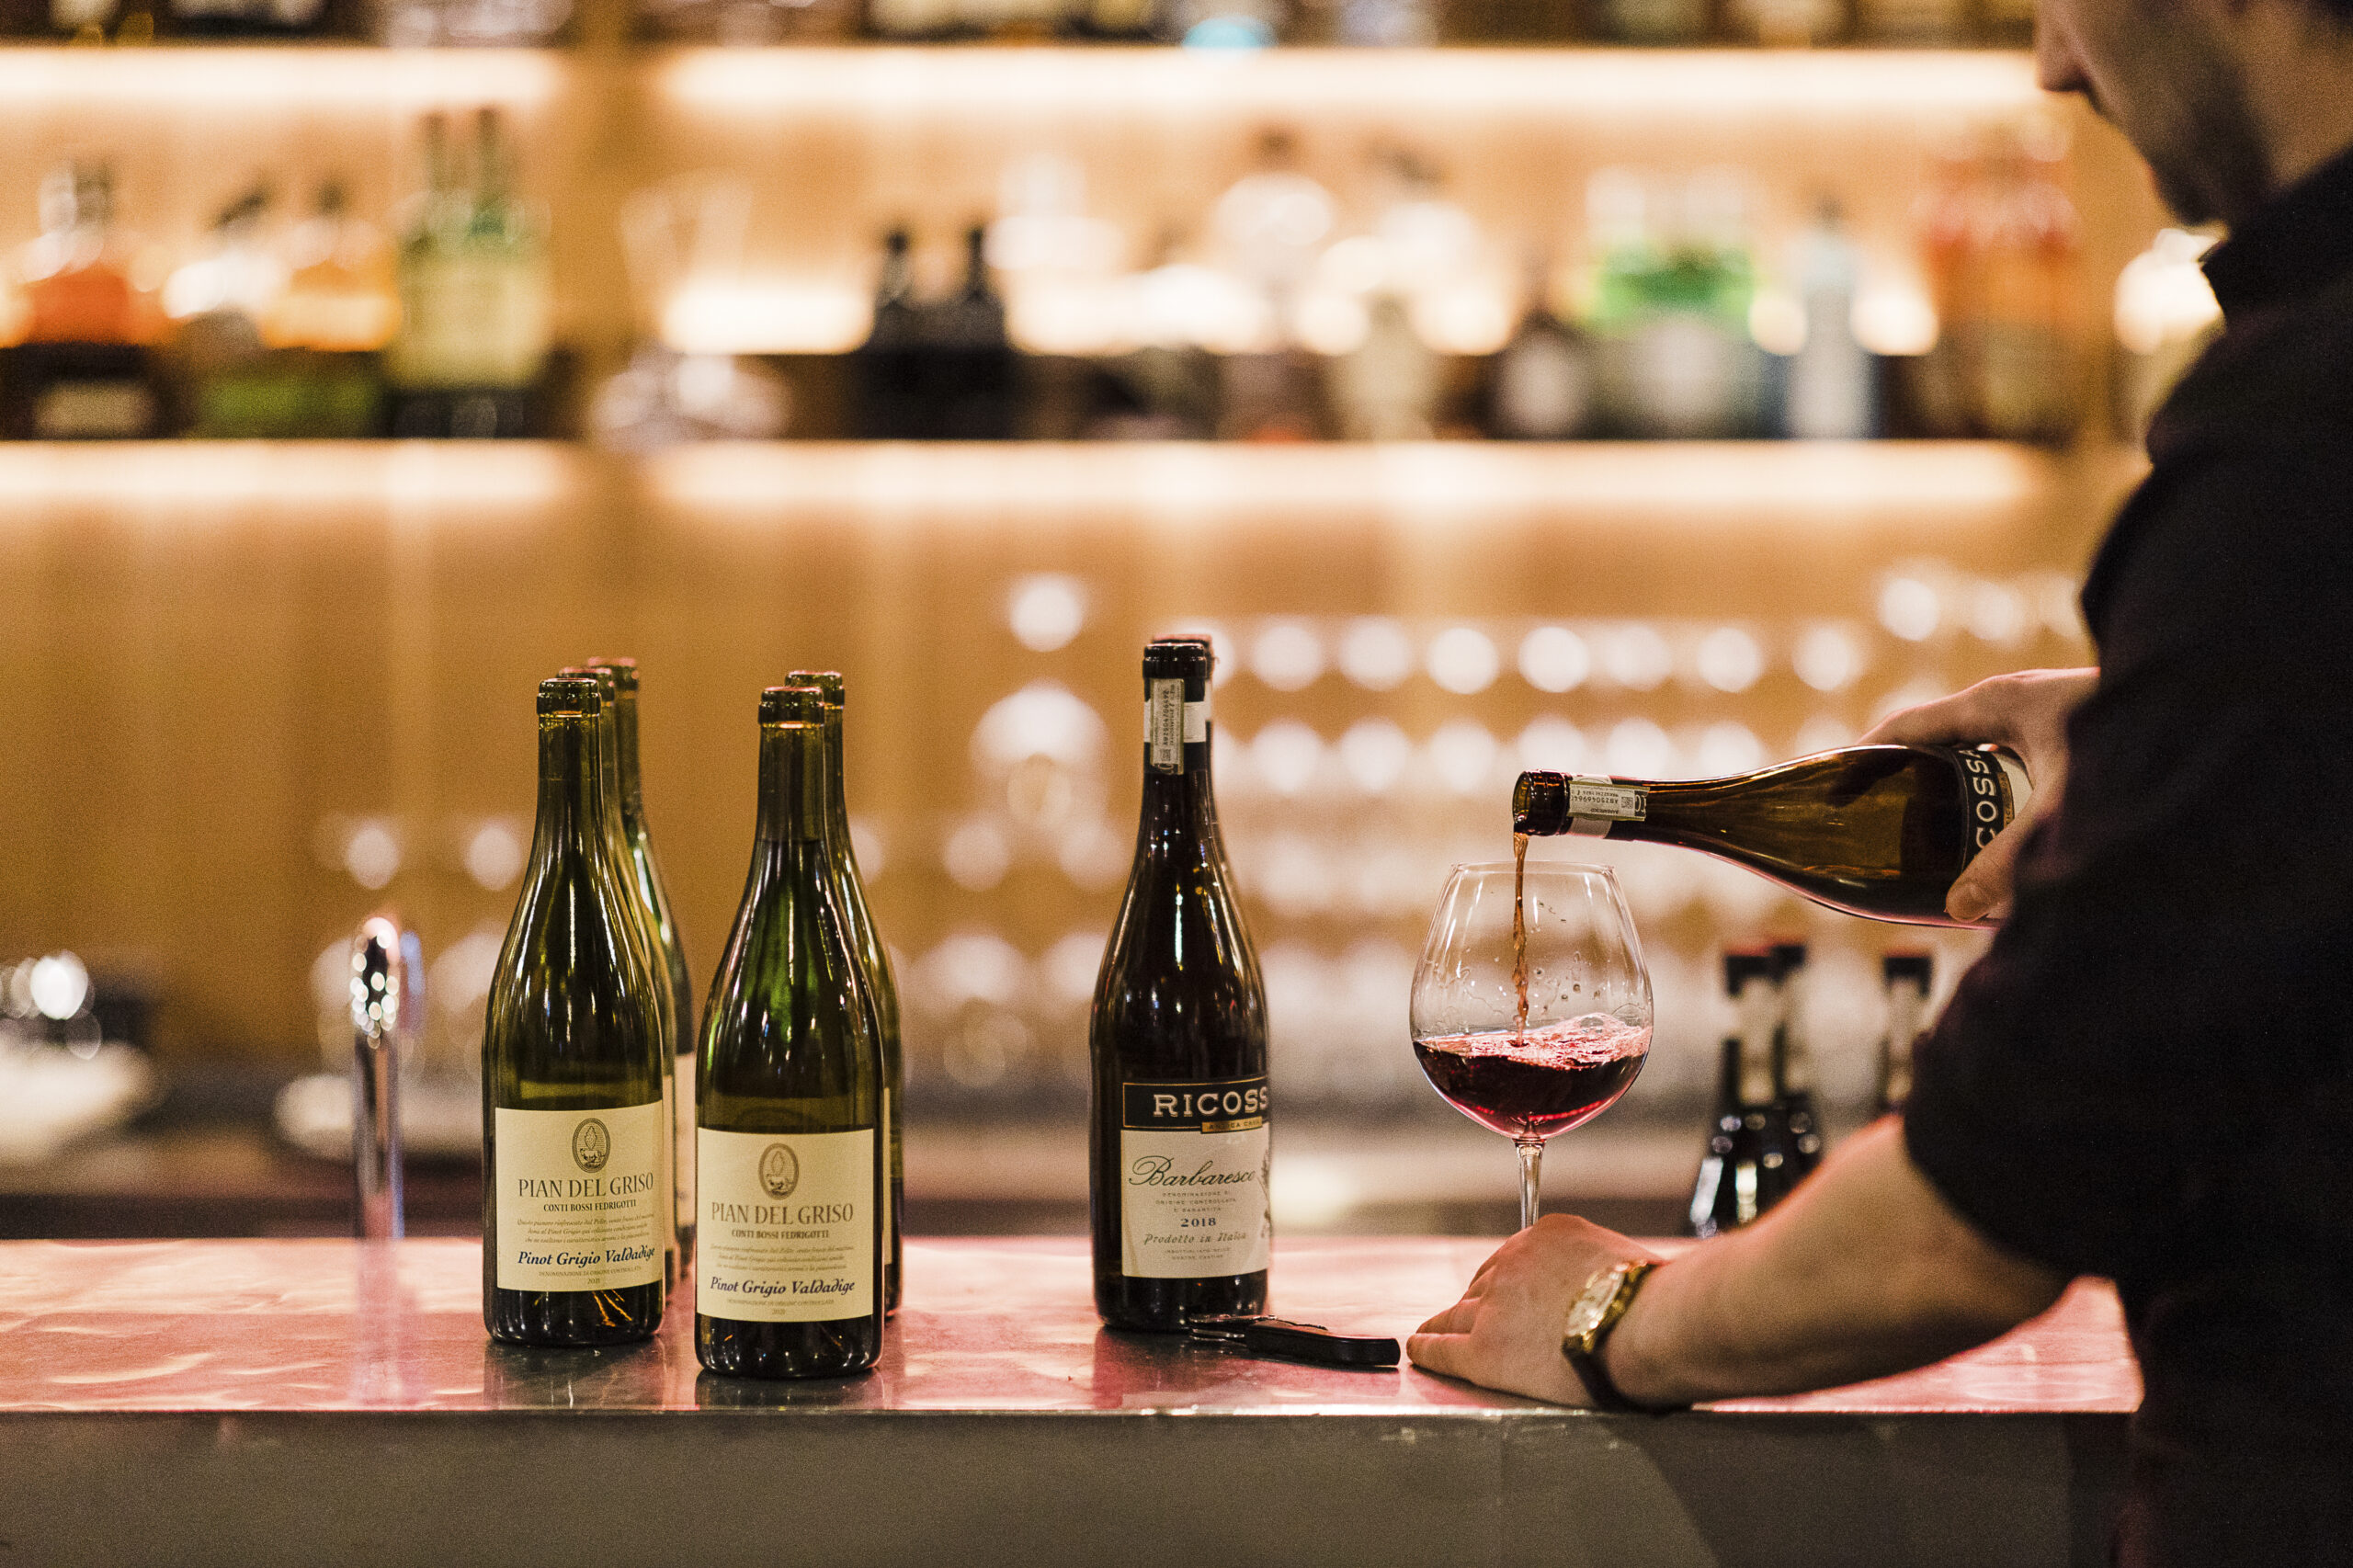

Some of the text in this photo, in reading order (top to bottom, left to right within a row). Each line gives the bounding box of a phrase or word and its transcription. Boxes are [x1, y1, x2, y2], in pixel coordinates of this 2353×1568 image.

[1959, 749, 1996, 849] COSSA
[1153, 1085, 1268, 1118] RICOSS
[1128, 1154, 1256, 1187] Barbaresco
[518, 1172, 654, 1198] PIAN DEL GRISO
[543, 1199, 637, 1212] CONTI BOSSI FEDRIGOTTI
[711, 1201, 854, 1225] PIAN DEL GRISO
[732, 1229, 829, 1239] CONTI BOSSI FEDRIGOTTI
[1180, 1217, 1217, 1228] 2018
[1143, 1232, 1247, 1245] Prodotto in Italia
[517, 1244, 655, 1268] Pinot Grigio Valdadige
[710, 1276, 856, 1299] Pinot Grigio Valdadige
